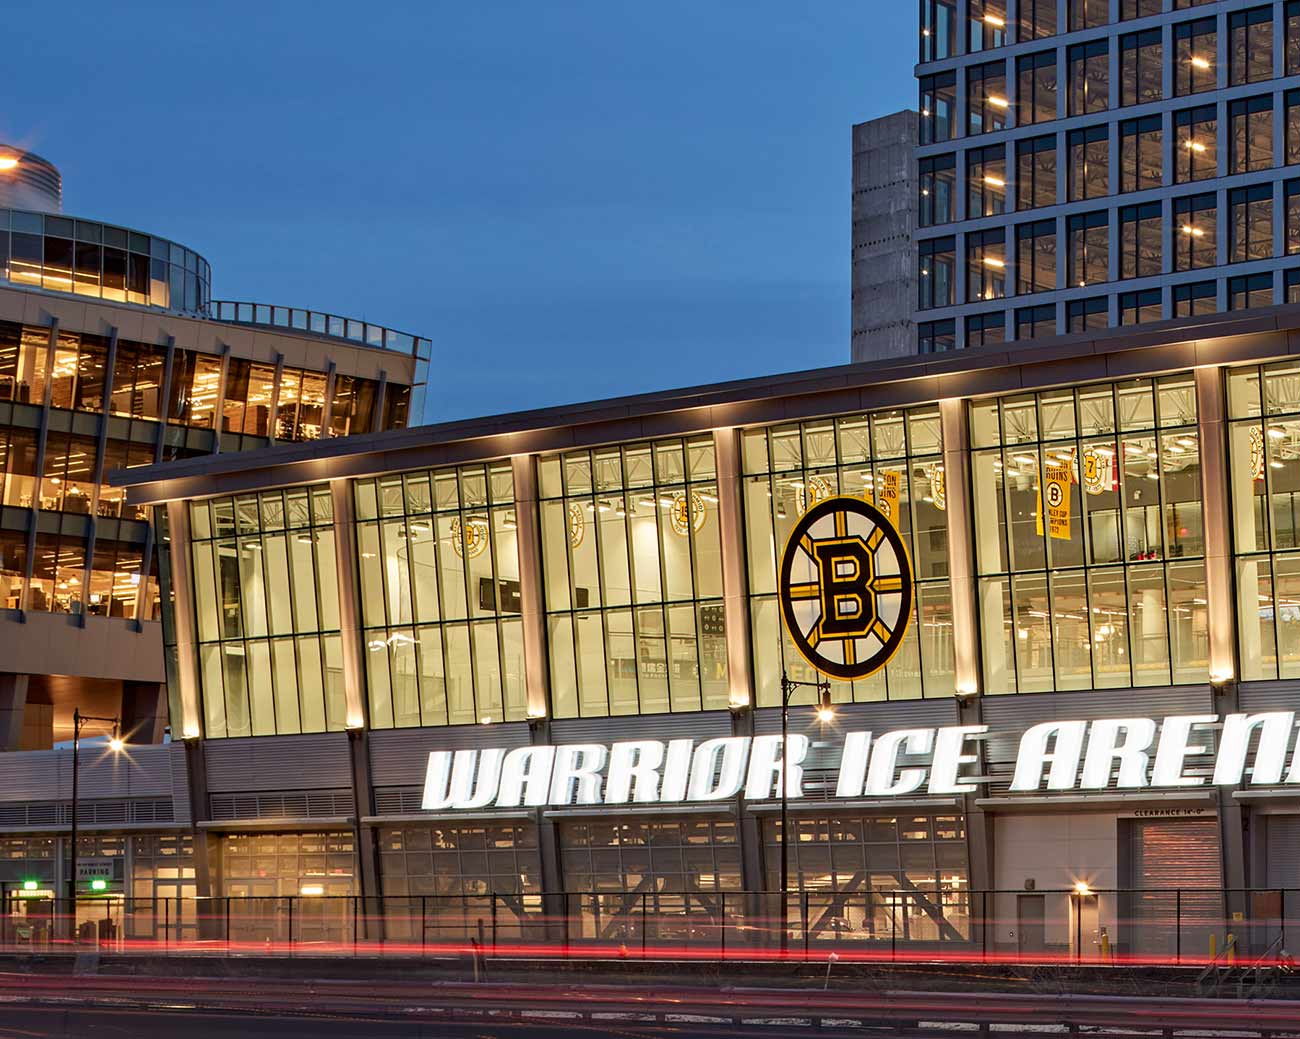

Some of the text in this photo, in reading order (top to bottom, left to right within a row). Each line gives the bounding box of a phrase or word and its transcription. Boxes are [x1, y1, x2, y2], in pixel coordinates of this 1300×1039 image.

[1088, 460, 1094, 473] 7
[1051, 487, 1059, 502] B
[812, 535, 877, 642] B
[421, 734, 809, 810] WARRIOR
[836, 725, 988, 797] ICE
[1134, 809, 1180, 817] CLEARANCE
[80, 868, 110, 876] PARKING
